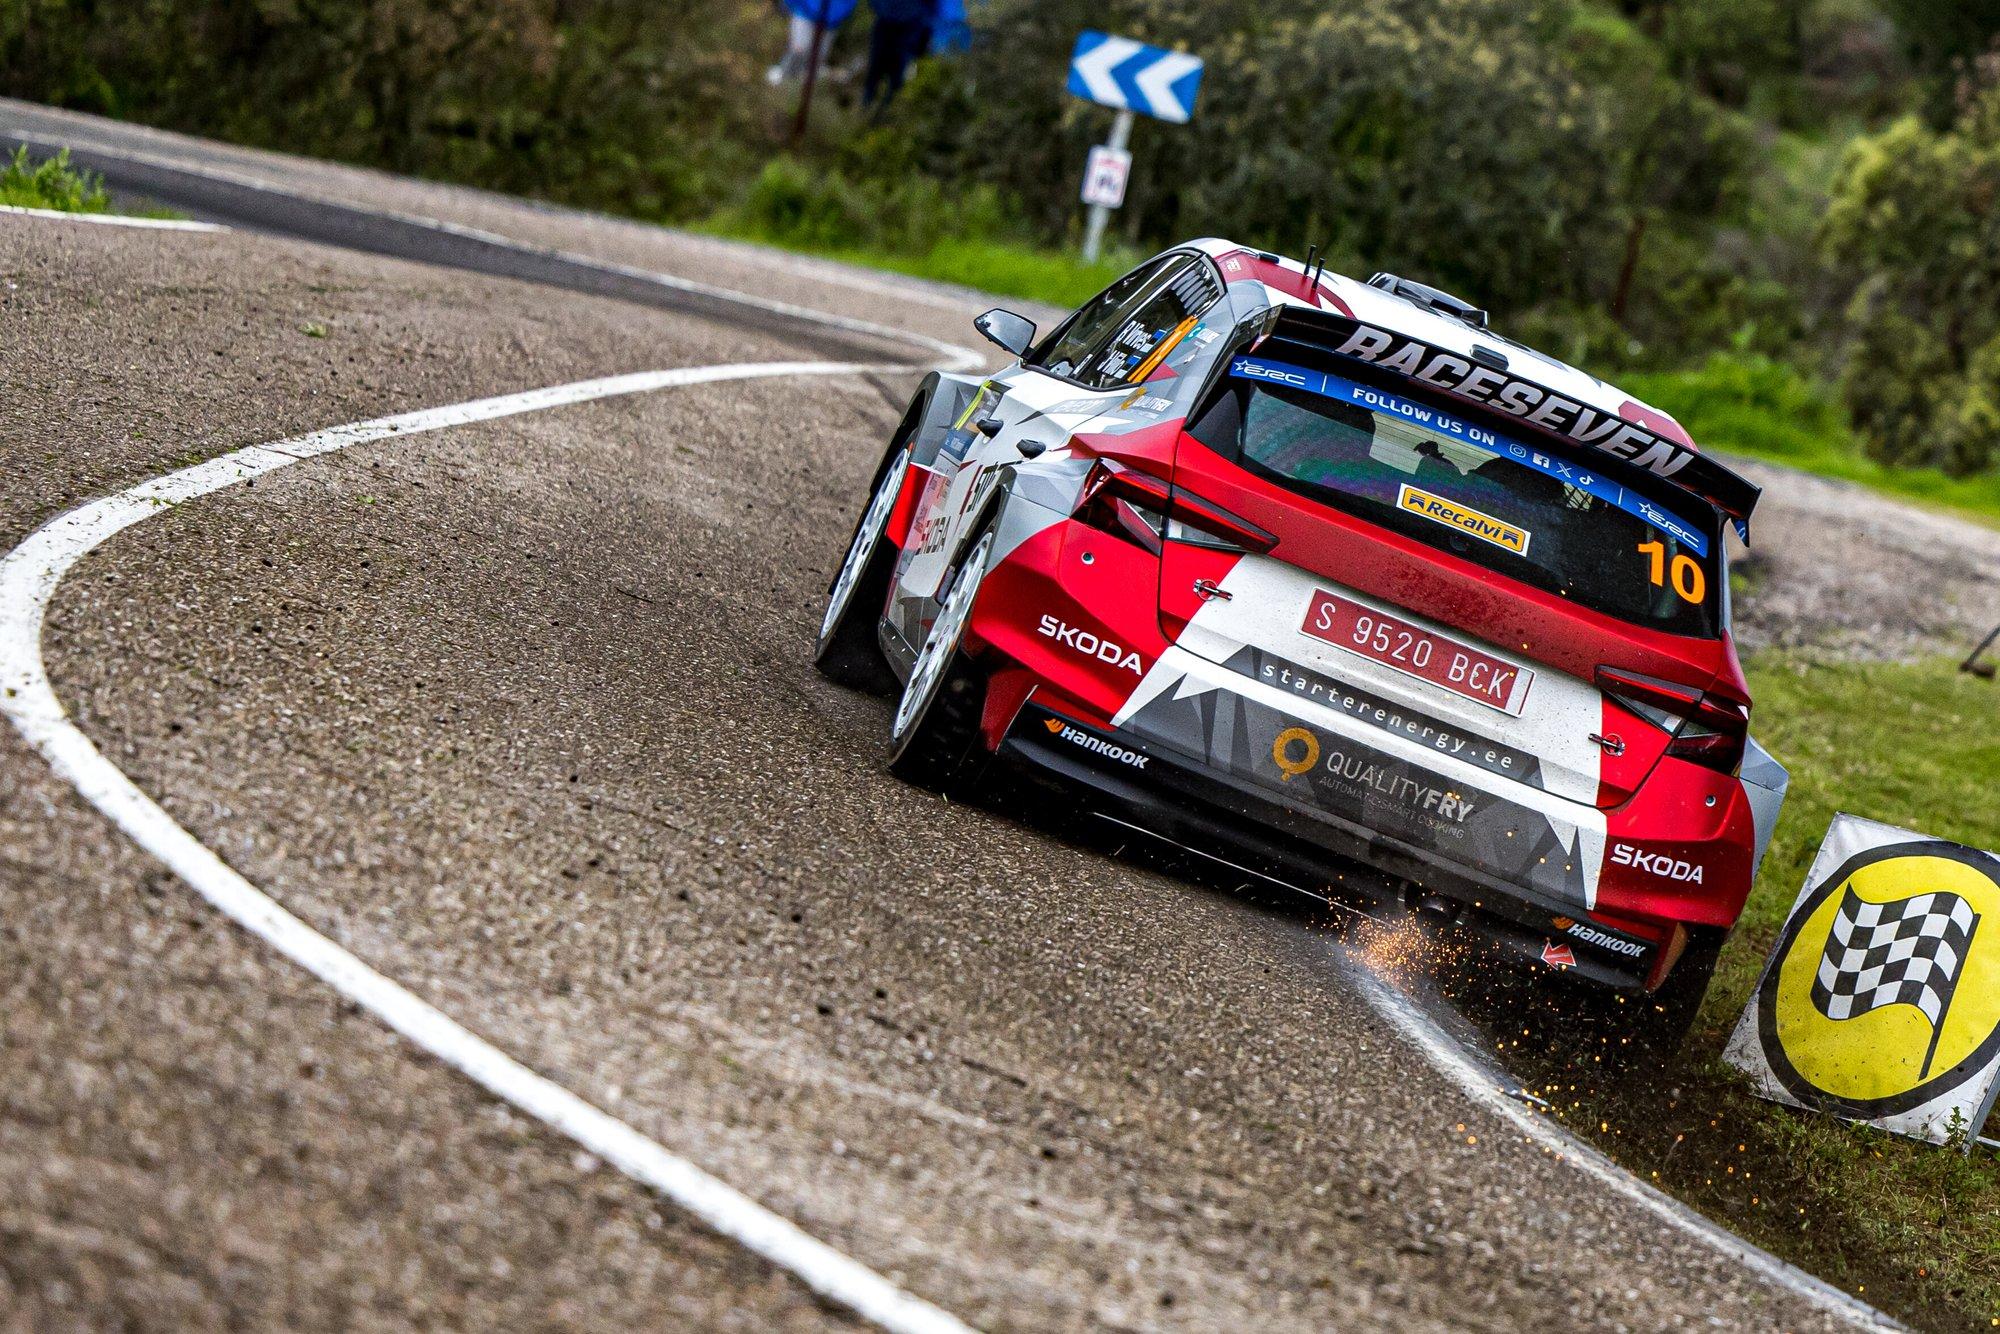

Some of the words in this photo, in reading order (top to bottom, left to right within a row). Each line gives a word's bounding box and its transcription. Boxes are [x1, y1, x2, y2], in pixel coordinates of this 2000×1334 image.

[1243, 364, 1305, 386] ERC
[1336, 325, 1694, 477] RACESEVEN
[1353, 388, 1432, 423] FOLLOW
[1437, 416, 1462, 434] US
[1469, 429, 1495, 446] ON
[1425, 499, 1502, 541] Recalvi
[1648, 510, 1699, 548] ERC
[1638, 540, 1705, 604] 10
[1315, 602, 1336, 630] S
[1353, 616, 1432, 668] 9520
[1448, 653, 1510, 699] BCK
[1263, 664, 1512, 768] starterenergy.ee
[1326, 751, 1475, 822] QUALITYFRY
